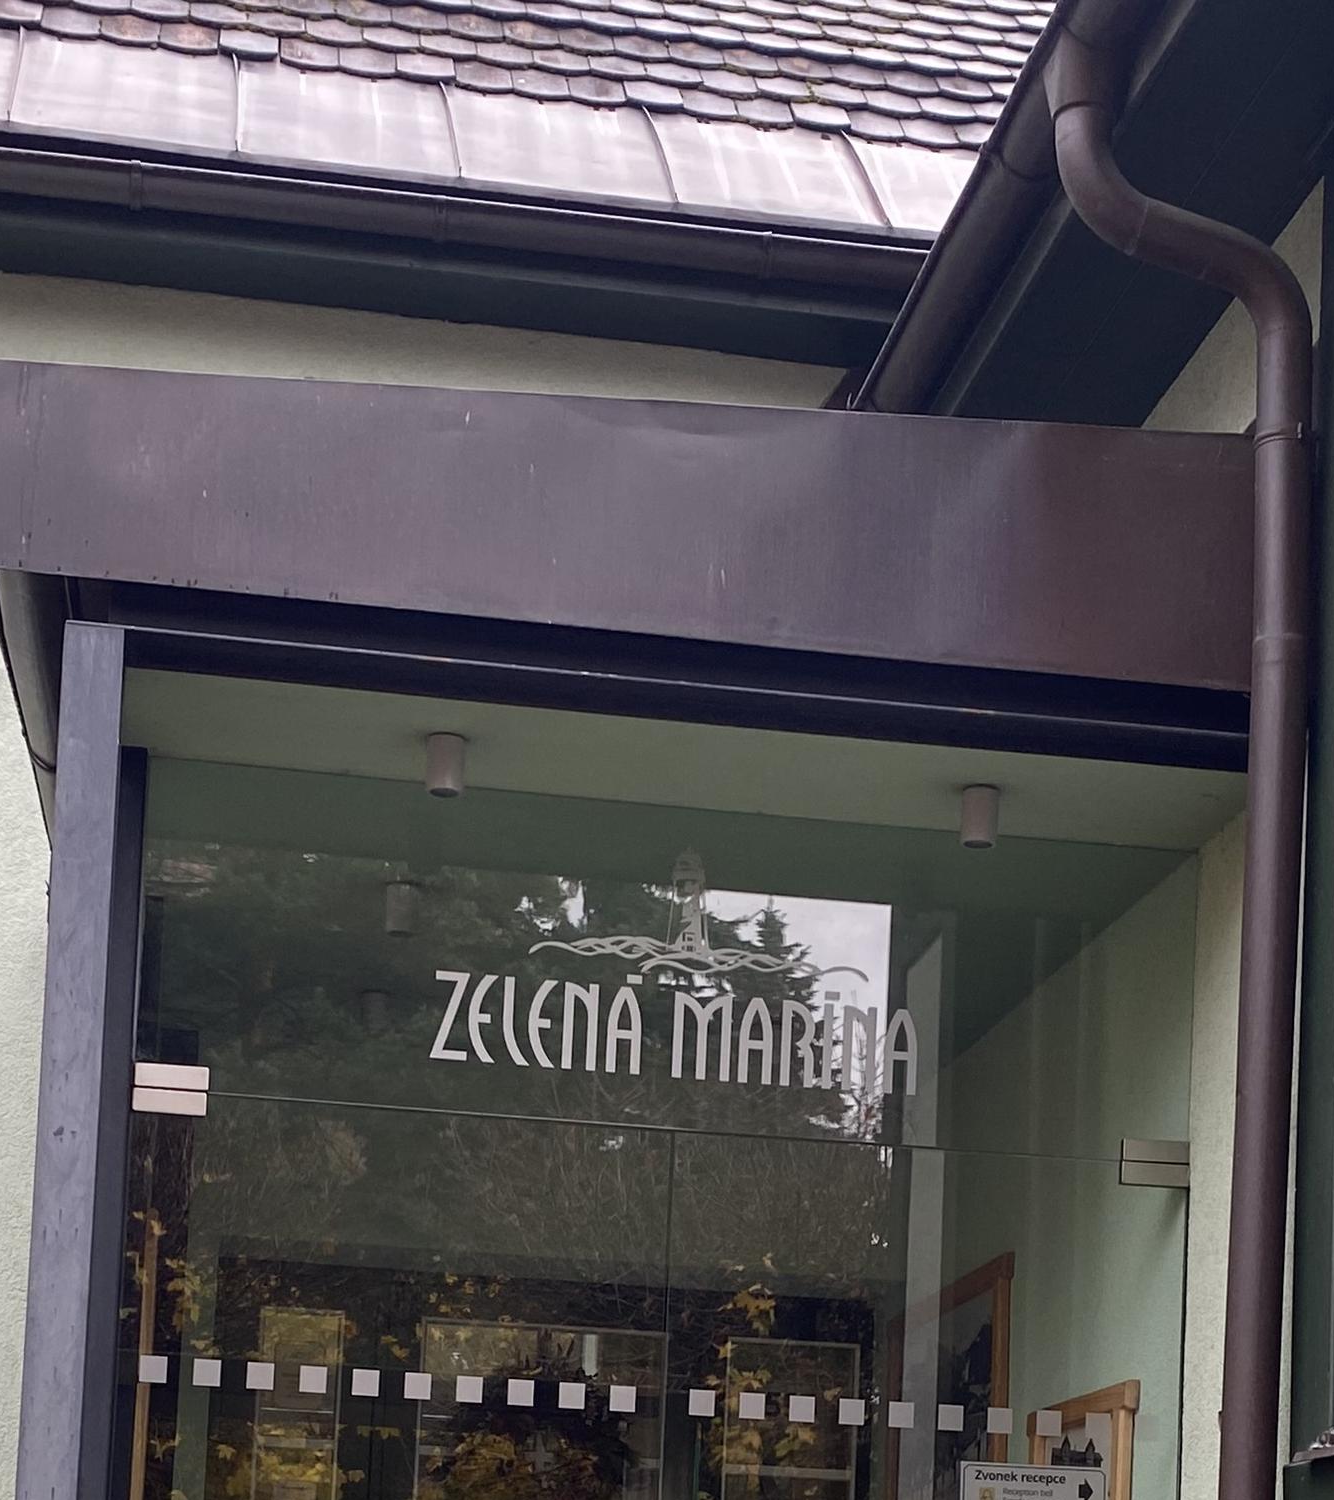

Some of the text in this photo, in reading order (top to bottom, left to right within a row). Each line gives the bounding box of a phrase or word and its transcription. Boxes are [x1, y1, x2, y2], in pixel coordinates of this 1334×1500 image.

[429, 969, 643, 1075] ZELENÁ
[974, 1469, 1066, 1486] Zvonek recepce
